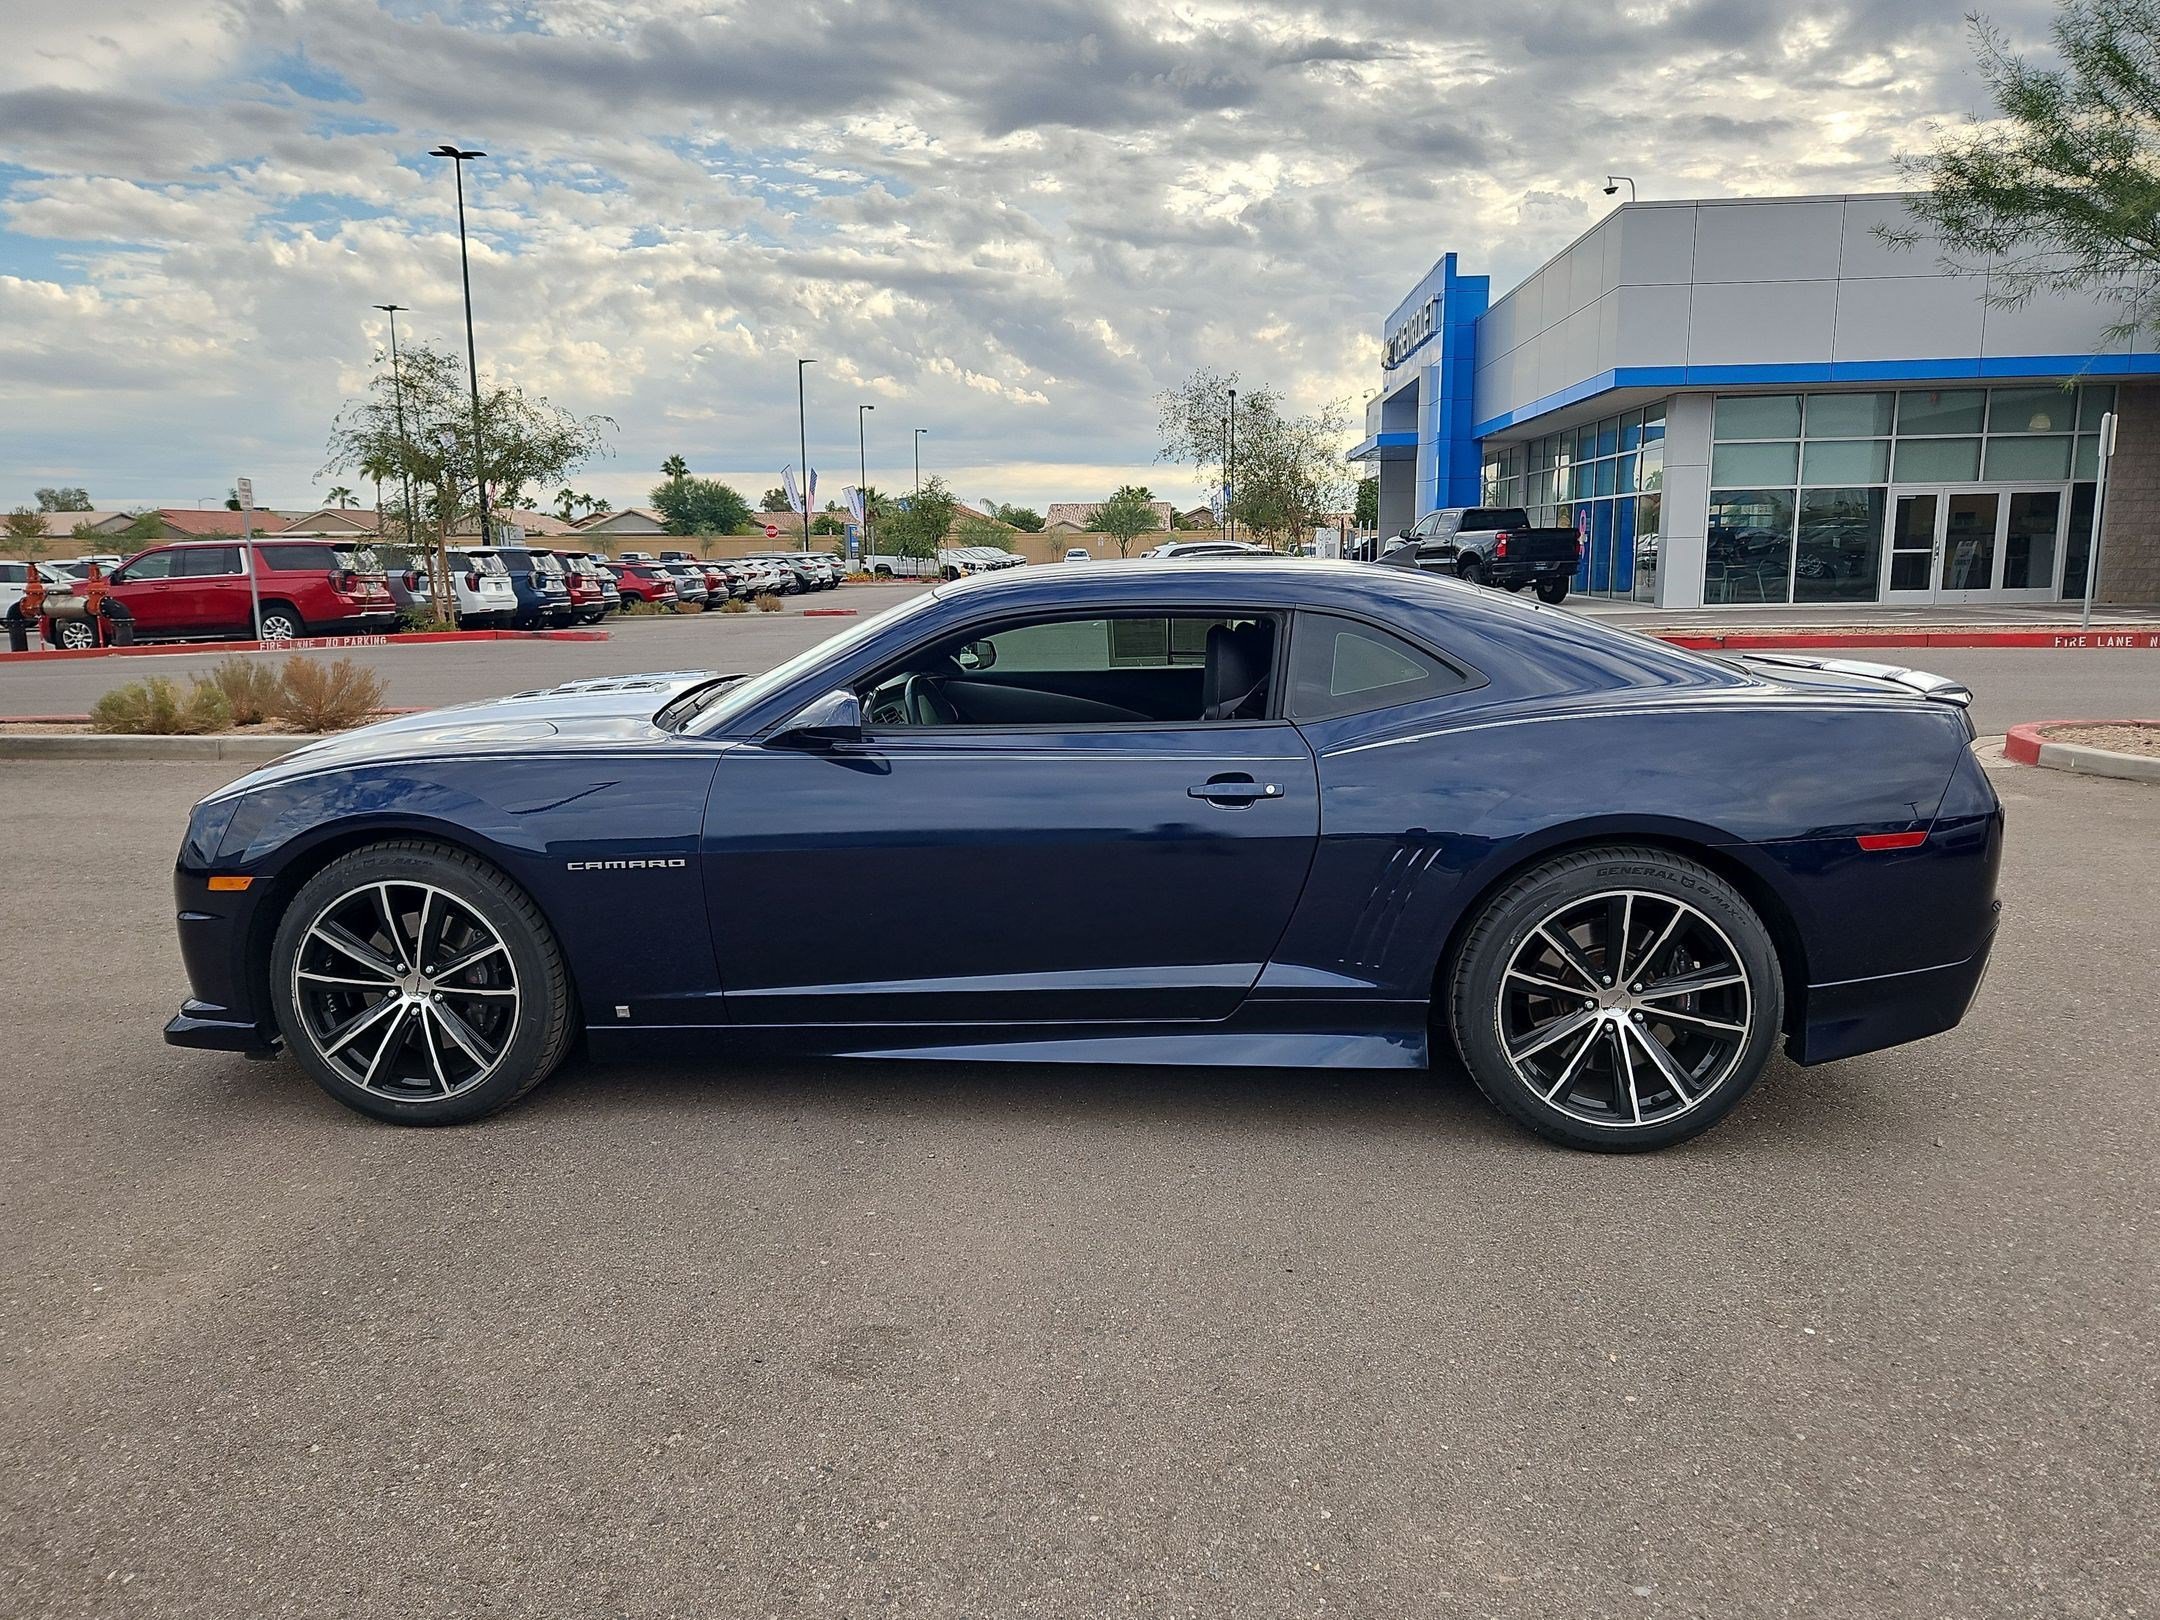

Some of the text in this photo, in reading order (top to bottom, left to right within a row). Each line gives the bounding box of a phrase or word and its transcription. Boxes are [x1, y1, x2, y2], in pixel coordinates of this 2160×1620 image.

[1394, 293, 1443, 364] CHEVROLET
[259, 641, 282, 651] FIRE
[326, 638, 338, 647] NO
[344, 636, 387, 647] PARKING
[2055, 636, 2160, 647] FIRE LANE N
[567, 859, 686, 871] CAMARO
[1596, 866, 1677, 882] GENERAL
